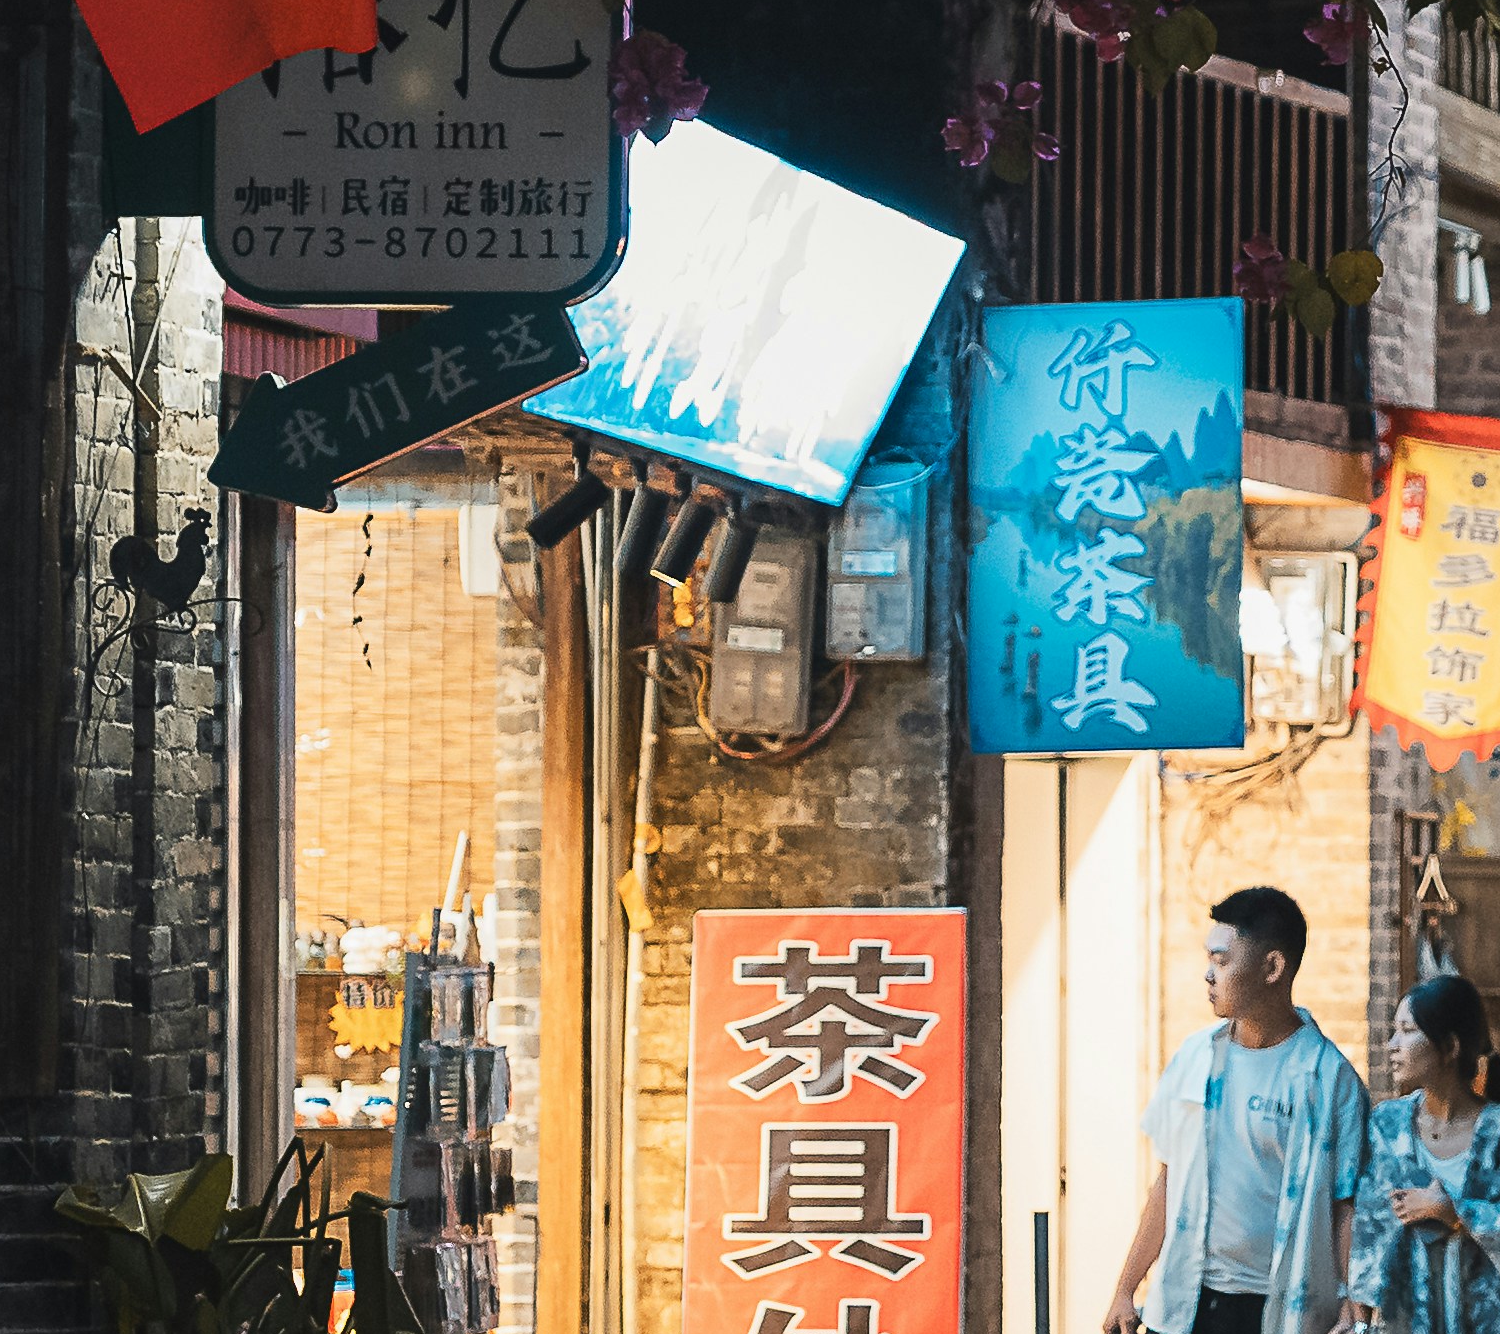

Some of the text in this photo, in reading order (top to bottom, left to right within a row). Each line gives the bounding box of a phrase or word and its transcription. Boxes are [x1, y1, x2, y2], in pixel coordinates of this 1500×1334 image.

[334, 109, 509, 150] Ron inn
[234, 175, 593, 218] 咖啡 民宿 定制旅行
[230, 225, 592, 261] 0773-8702111
[279, 307, 558, 471] 我们在这
